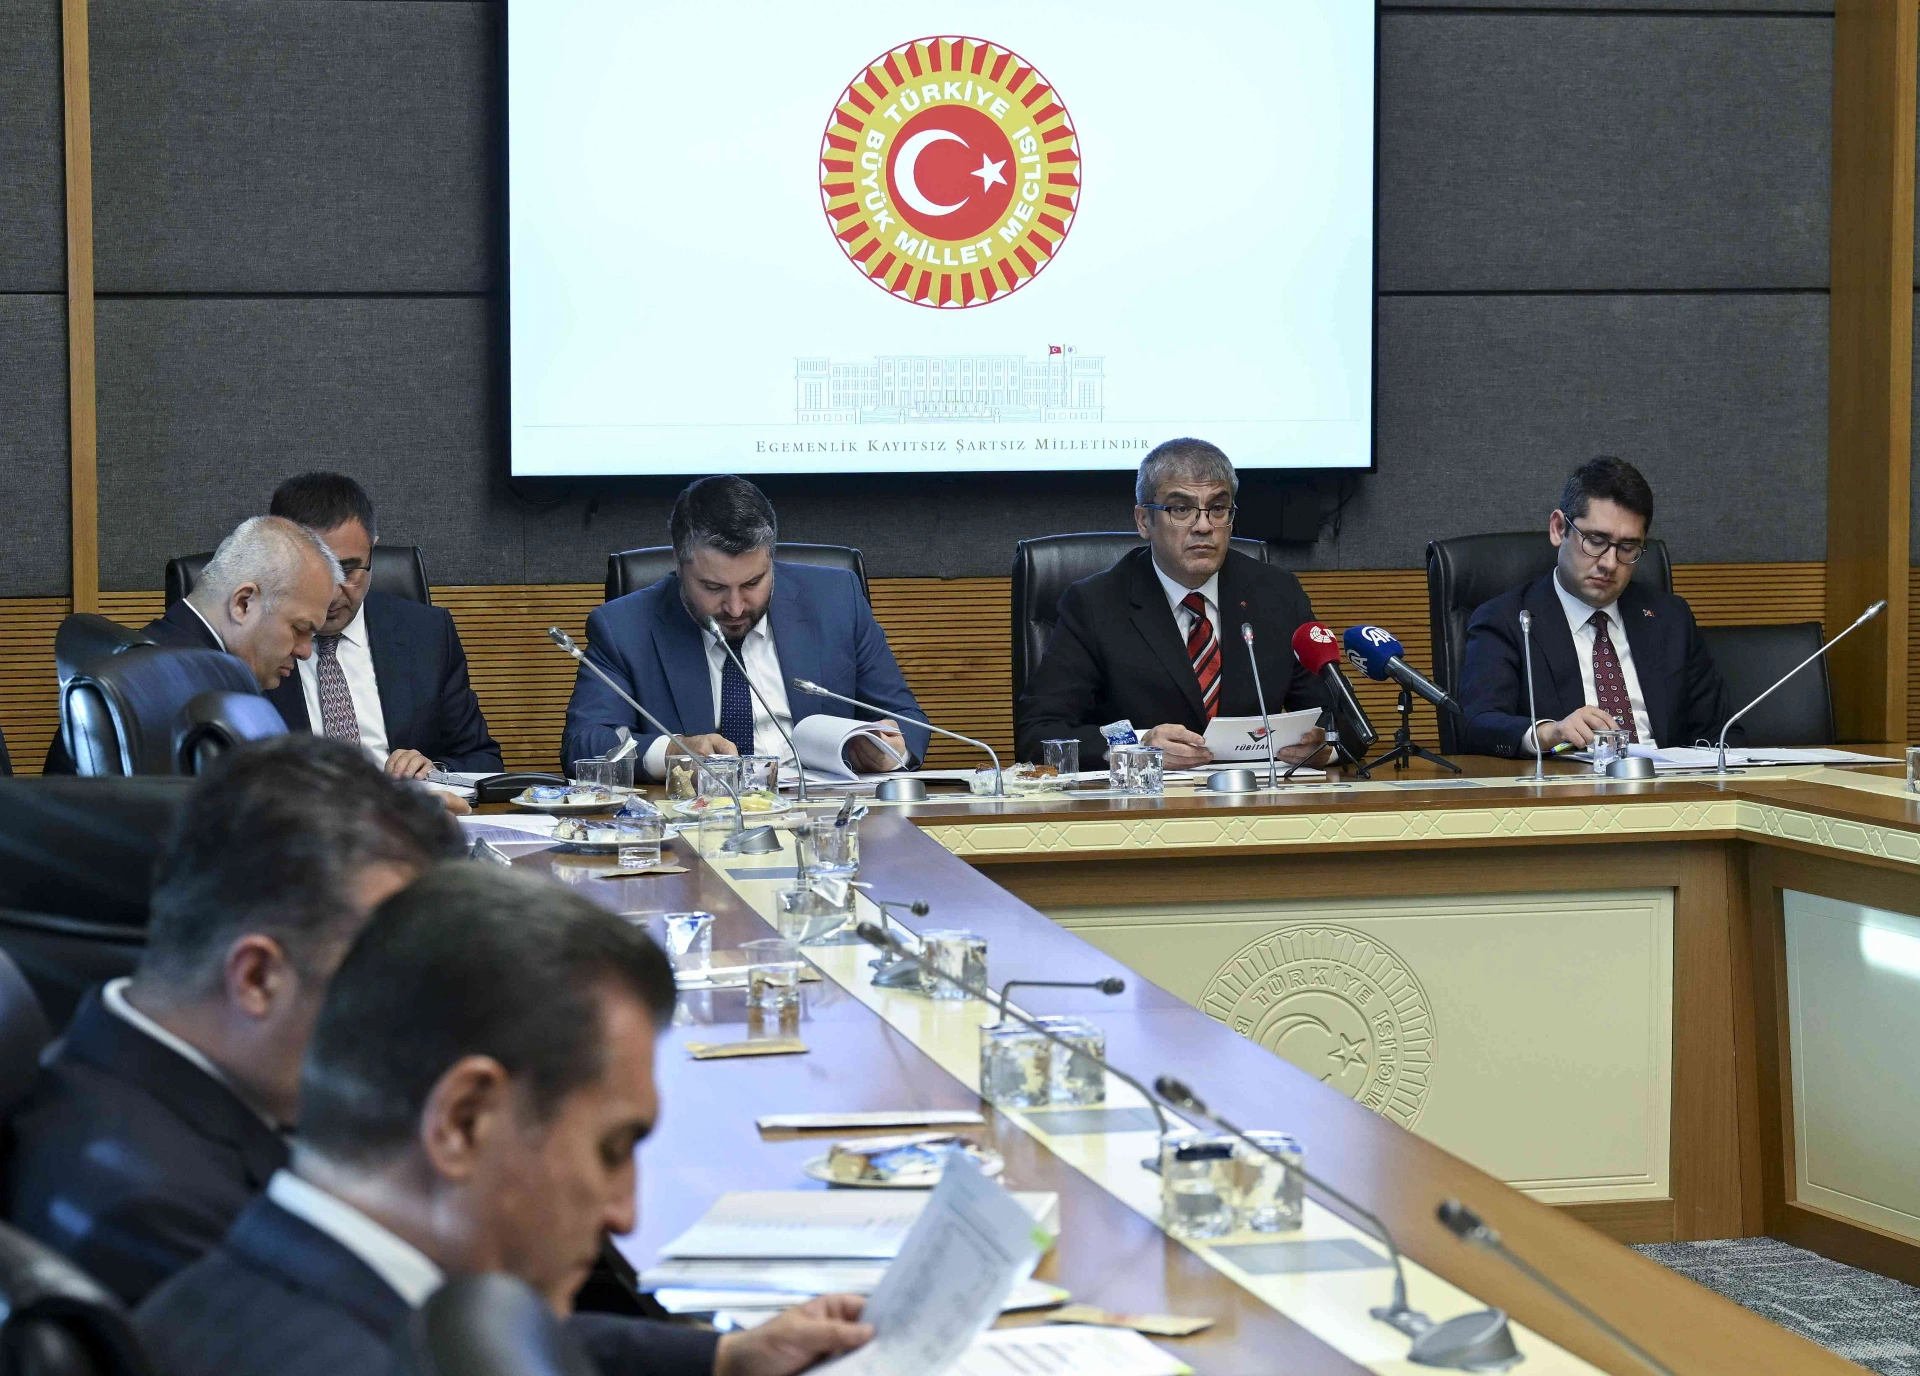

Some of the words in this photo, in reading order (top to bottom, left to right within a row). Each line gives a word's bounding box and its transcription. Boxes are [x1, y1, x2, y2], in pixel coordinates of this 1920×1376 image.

[883, 80, 1010, 123] TÜRKİYE
[861, 128, 896, 233] BÜYÜK
[997, 125, 1042, 244] MECLİSİ
[893, 230, 994, 266] MİLLET
[755, 440, 858, 453] EGEMENLİK
[868, 439, 947, 452] KAYITSIZ
[955, 438, 1026, 454] ŞARTSIZ
[1250, 965, 1375, 1008] TÜRKİYE
